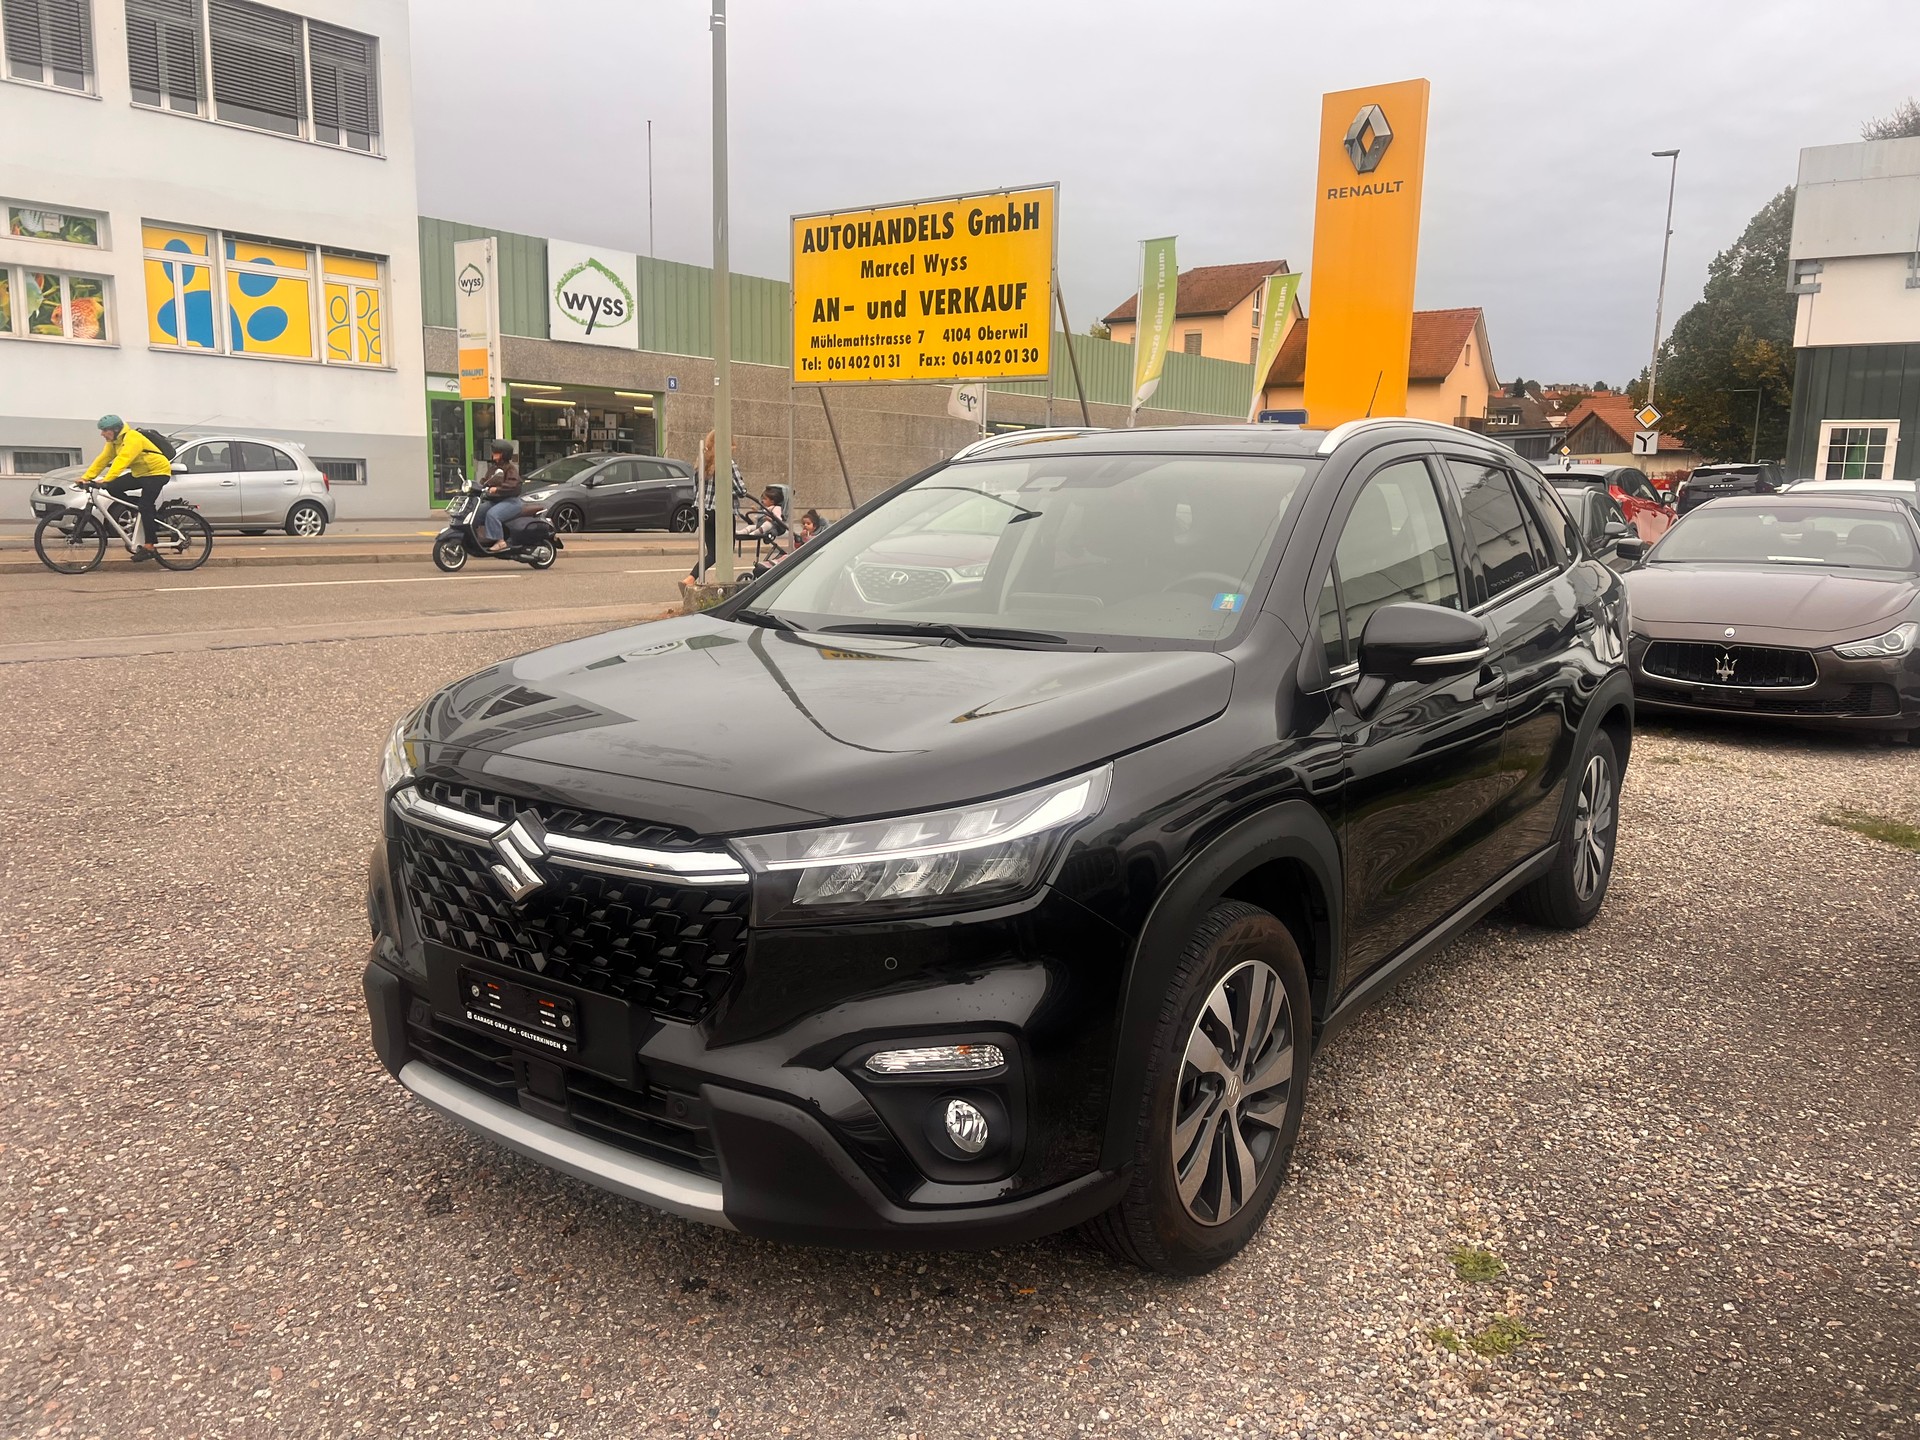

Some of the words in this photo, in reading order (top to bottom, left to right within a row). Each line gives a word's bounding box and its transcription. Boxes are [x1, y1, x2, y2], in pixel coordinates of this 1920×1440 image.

[1327, 180, 1404, 200] RENAULT
[802, 211, 954, 254] AUTOHANDELS
[967, 201, 1040, 237] GmbH
[860, 254, 915, 279] Marcel
[924, 255, 968, 276] Wyss
[1156, 248, 1165, 290] Traum.
[460, 277, 481, 297] wyss
[866, 290, 907, 320] und
[919, 282, 1028, 316] VERKAUF
[1274, 282, 1288, 318] Traum.
[563, 291, 624, 335] wyss
[1153, 292, 1165, 332] deinen
[810, 333, 912, 349] Mühlemattstrasse
[917, 330, 925, 344] 7
[942, 327, 971, 343] 4104
[977, 323, 1028, 341] Oberwil
[801, 356, 822, 371] Tel:
[919, 353, 946, 367] Fax:
[473, 1014, 494, 1026] GARAGE
[494, 1021, 508, 1031] GRAF
[508, 1026, 517, 1034] AG
[520, 1030, 561, 1049] GELTERKINDEN
